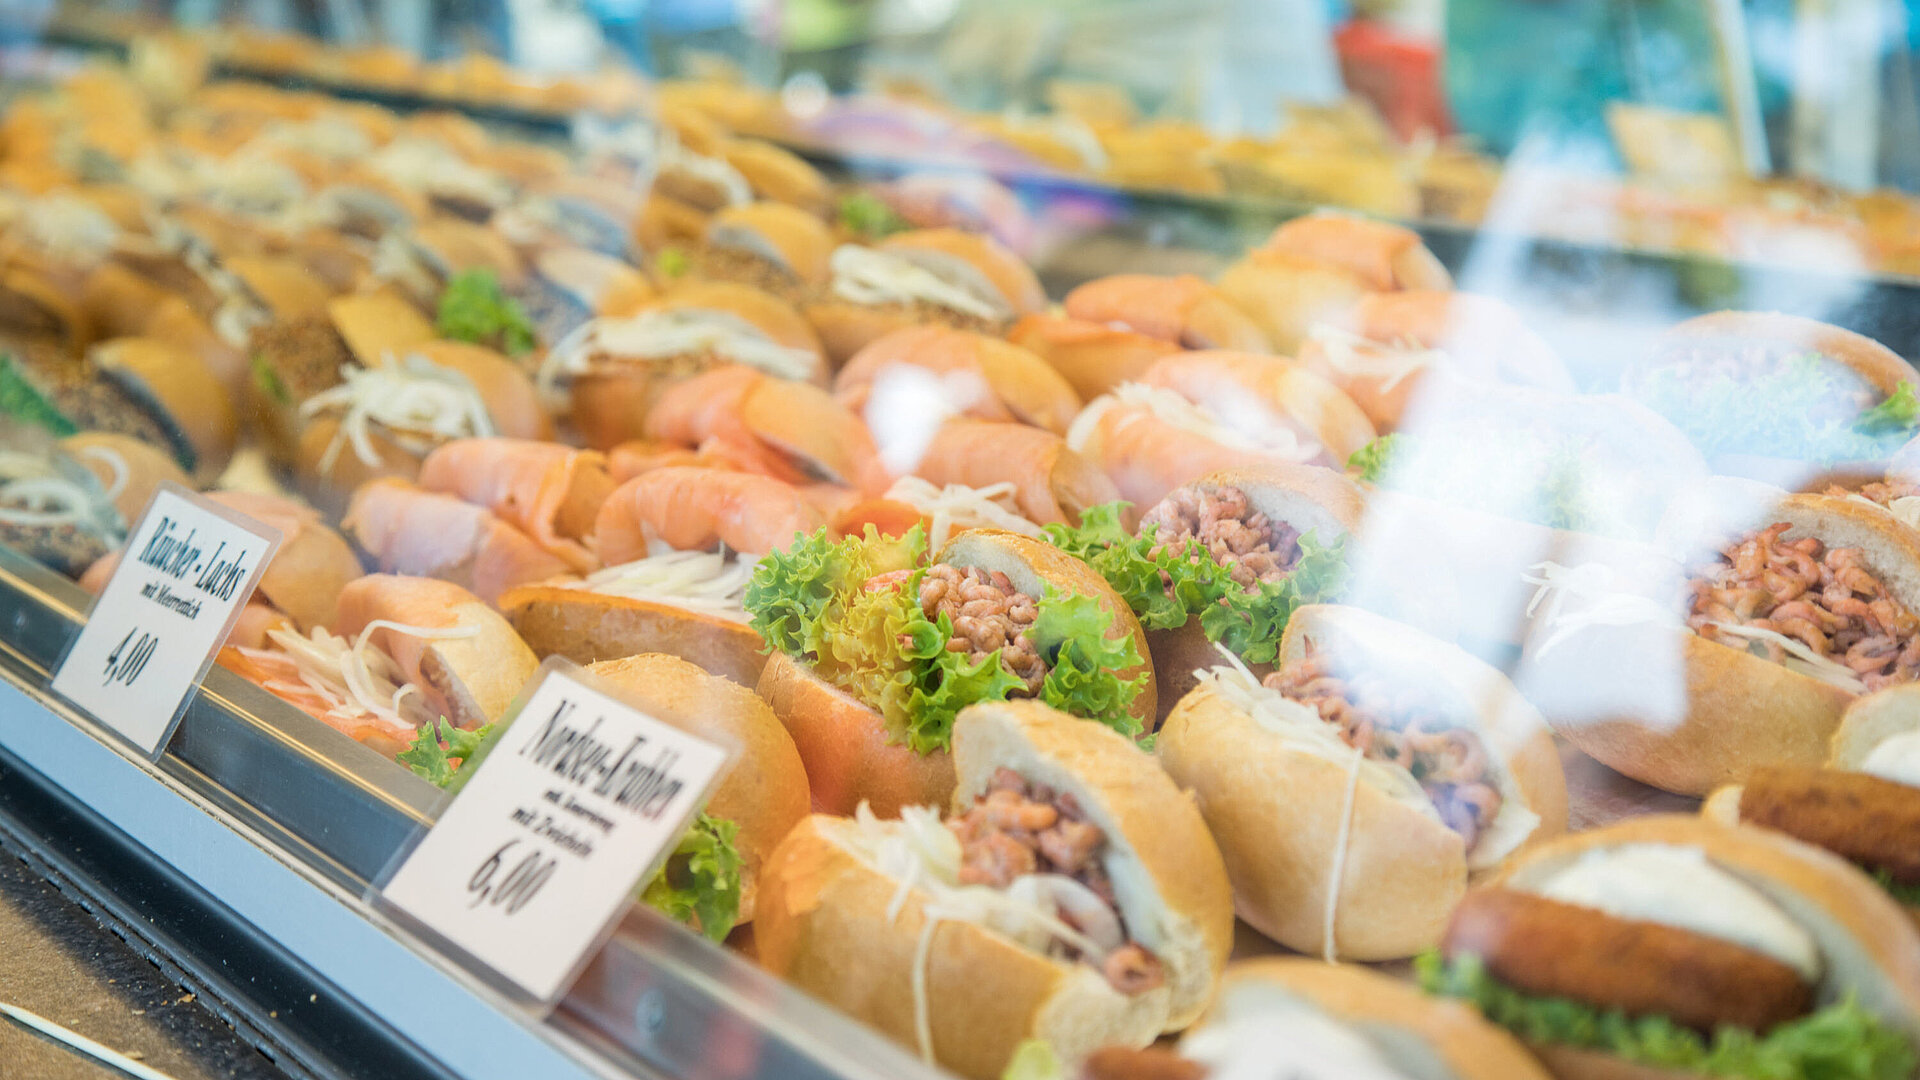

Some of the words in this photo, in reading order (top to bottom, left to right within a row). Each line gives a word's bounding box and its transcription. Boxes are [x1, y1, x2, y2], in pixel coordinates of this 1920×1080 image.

[140, 581, 160, 599] mit
[102, 626, 158, 687] 4,00
[511, 808, 537, 826] mit
[468, 838, 557, 916] 6,00
